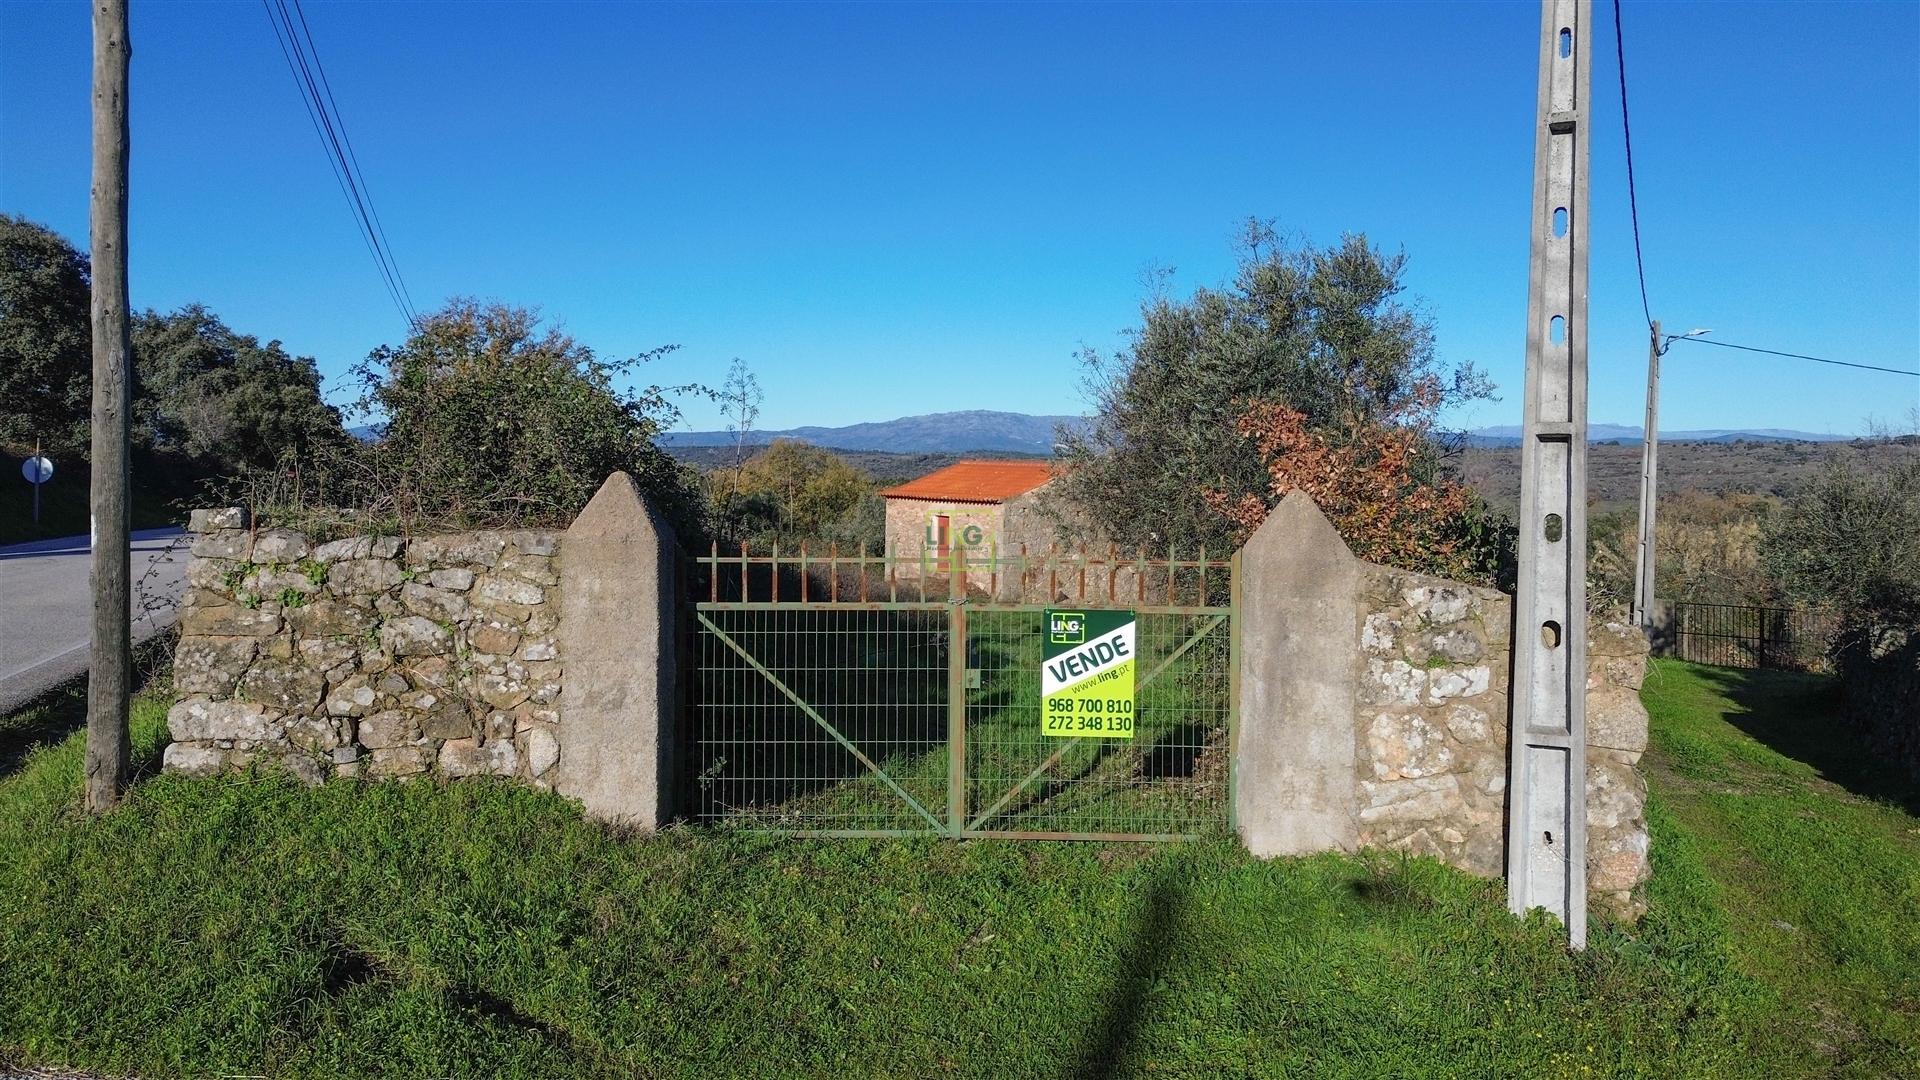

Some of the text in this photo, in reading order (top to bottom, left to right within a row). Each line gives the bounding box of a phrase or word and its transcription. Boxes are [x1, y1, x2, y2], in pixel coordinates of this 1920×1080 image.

[1051, 620, 1079, 631] LING
[1048, 634, 1130, 683] VENDE
[1071, 663, 1131, 694] www.ling.pt
[1048, 698, 1132, 713] 968 700 810
[1048, 715, 1132, 731] 272 348 130
